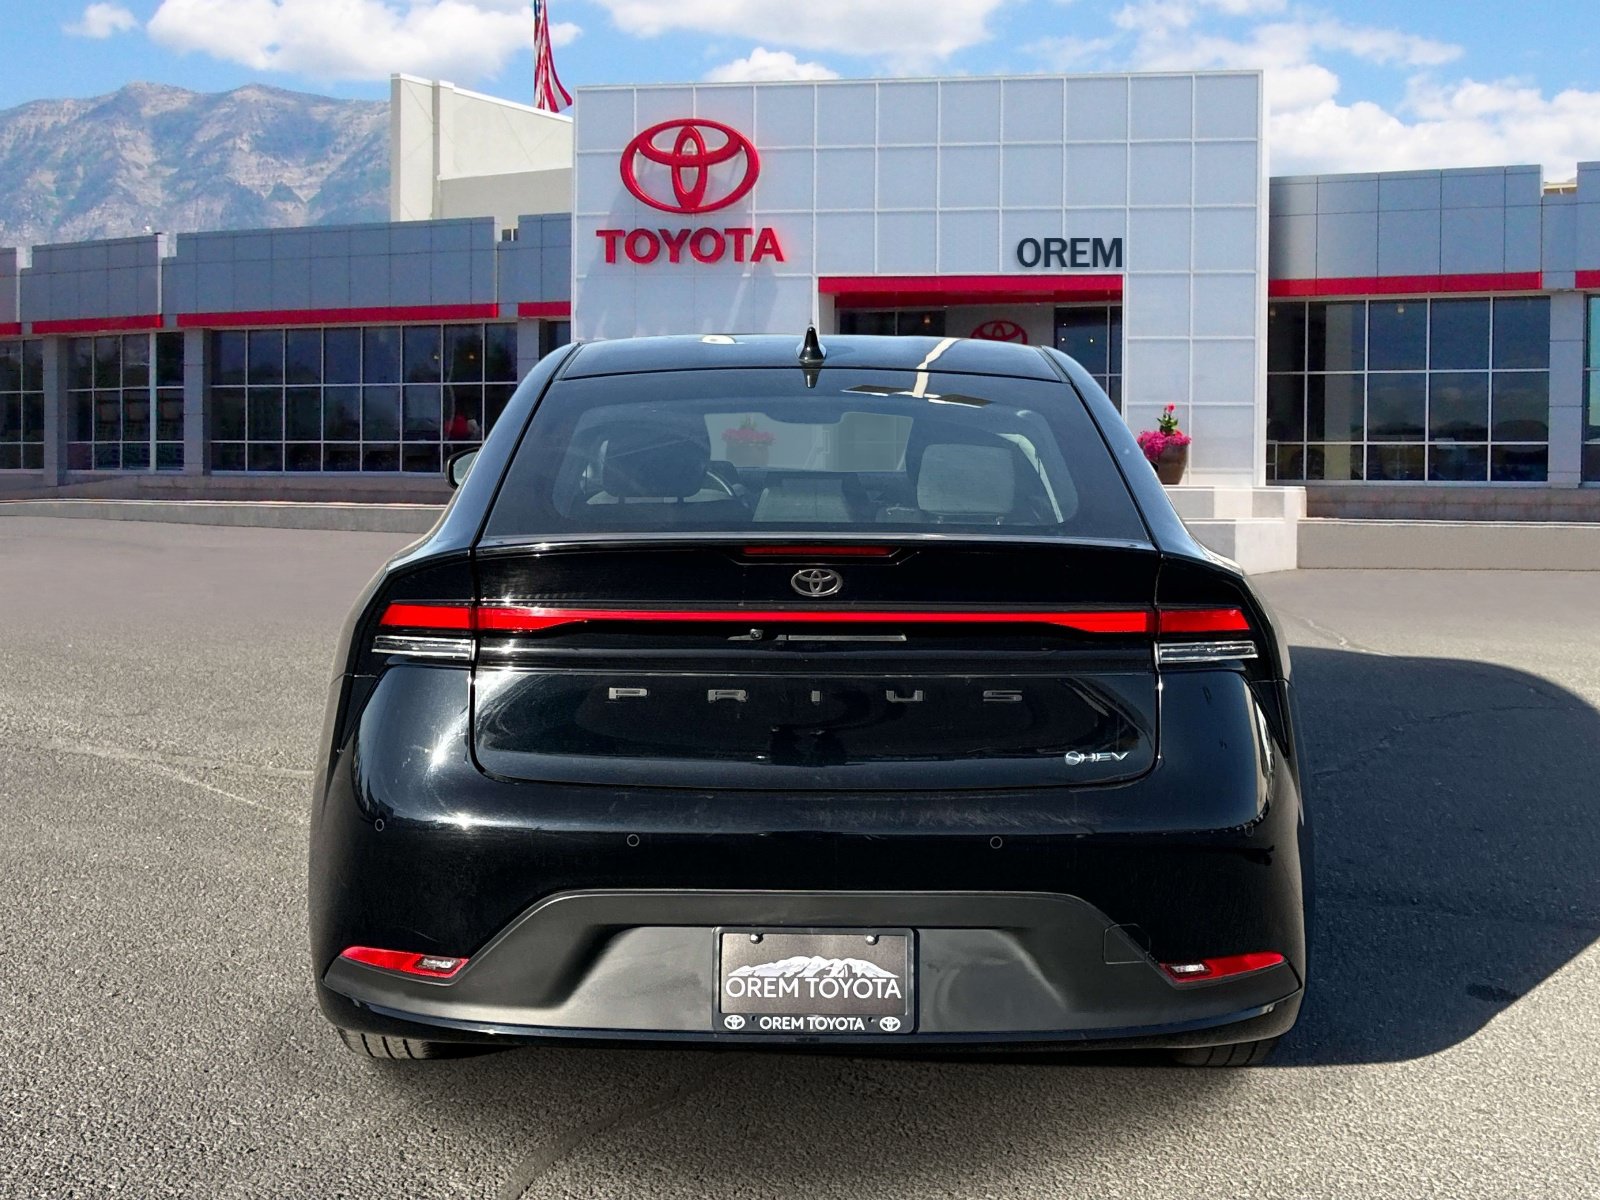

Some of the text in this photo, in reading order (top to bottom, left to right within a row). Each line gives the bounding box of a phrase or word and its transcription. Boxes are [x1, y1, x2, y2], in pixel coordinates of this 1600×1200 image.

[596, 227, 786, 265] TOYOTA
[1016, 237, 1123, 268] OREM
[608, 686, 1023, 703] PRIUS
[725, 976, 902, 999] OREM TOYOTA
[759, 1016, 865, 1031] OREM TOYOTA
